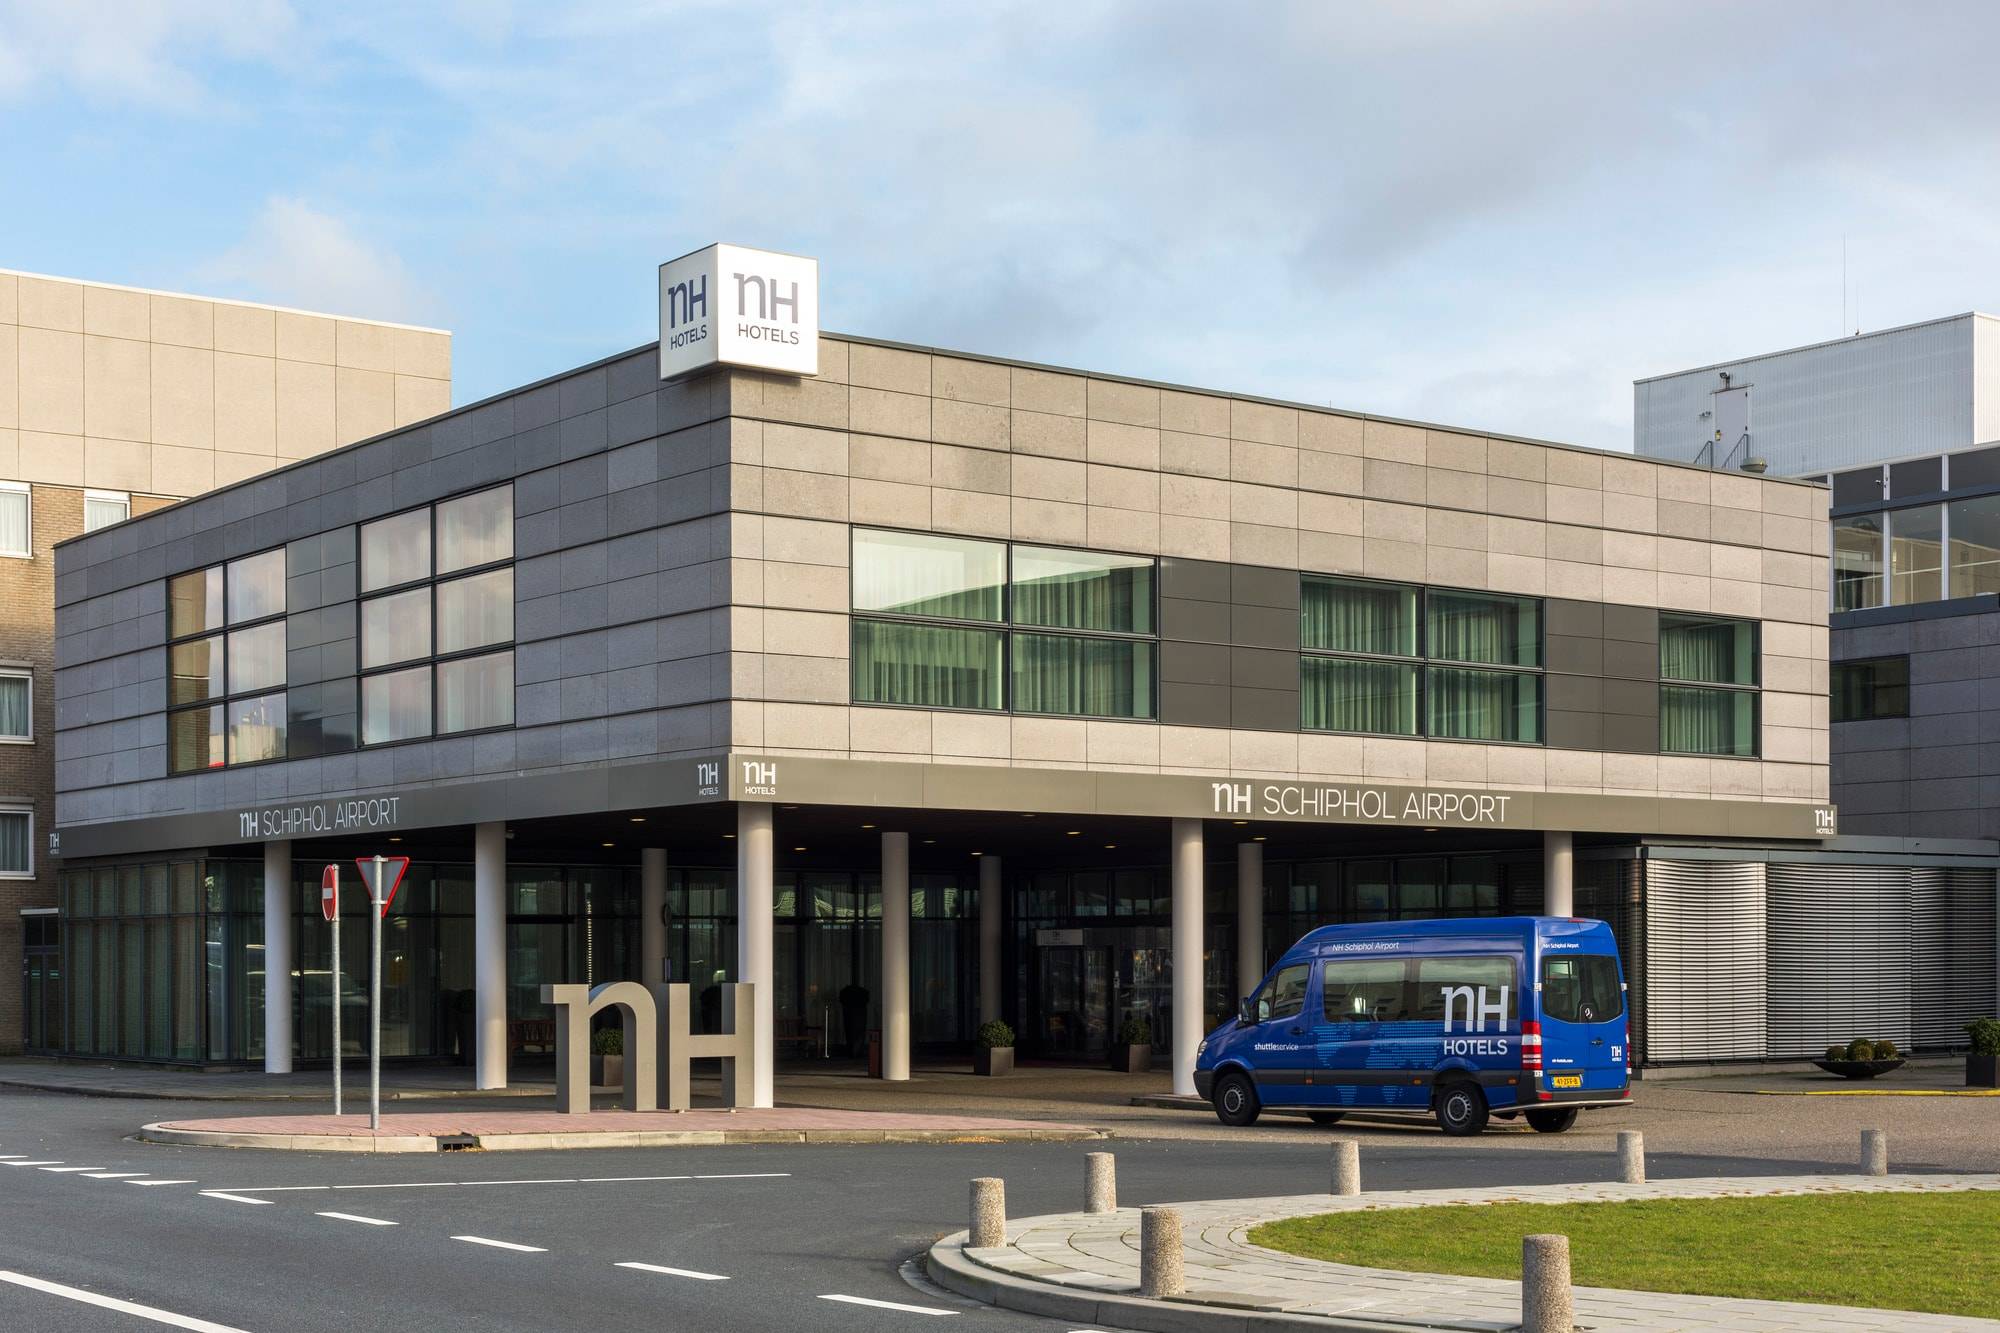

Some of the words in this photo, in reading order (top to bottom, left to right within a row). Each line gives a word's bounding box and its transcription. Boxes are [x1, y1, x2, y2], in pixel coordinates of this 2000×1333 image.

[670, 324, 708, 350] HOTELS
[738, 322, 799, 345] HOTELS
[744, 786, 776, 795] HOTELS
[1263, 785, 1396, 819] SCHIPHOL
[1402, 791, 1511, 823] AIRPORT
[263, 804, 332, 836] SCHIPHOL
[334, 796, 400, 829] AIRPORT
[1345, 942, 1374, 951] Schiphol
[1375, 941, 1400, 951] Airport
[1254, 1042, 1299, 1051] shuttleservice
[1443, 1039, 1508, 1055] HOTELS
